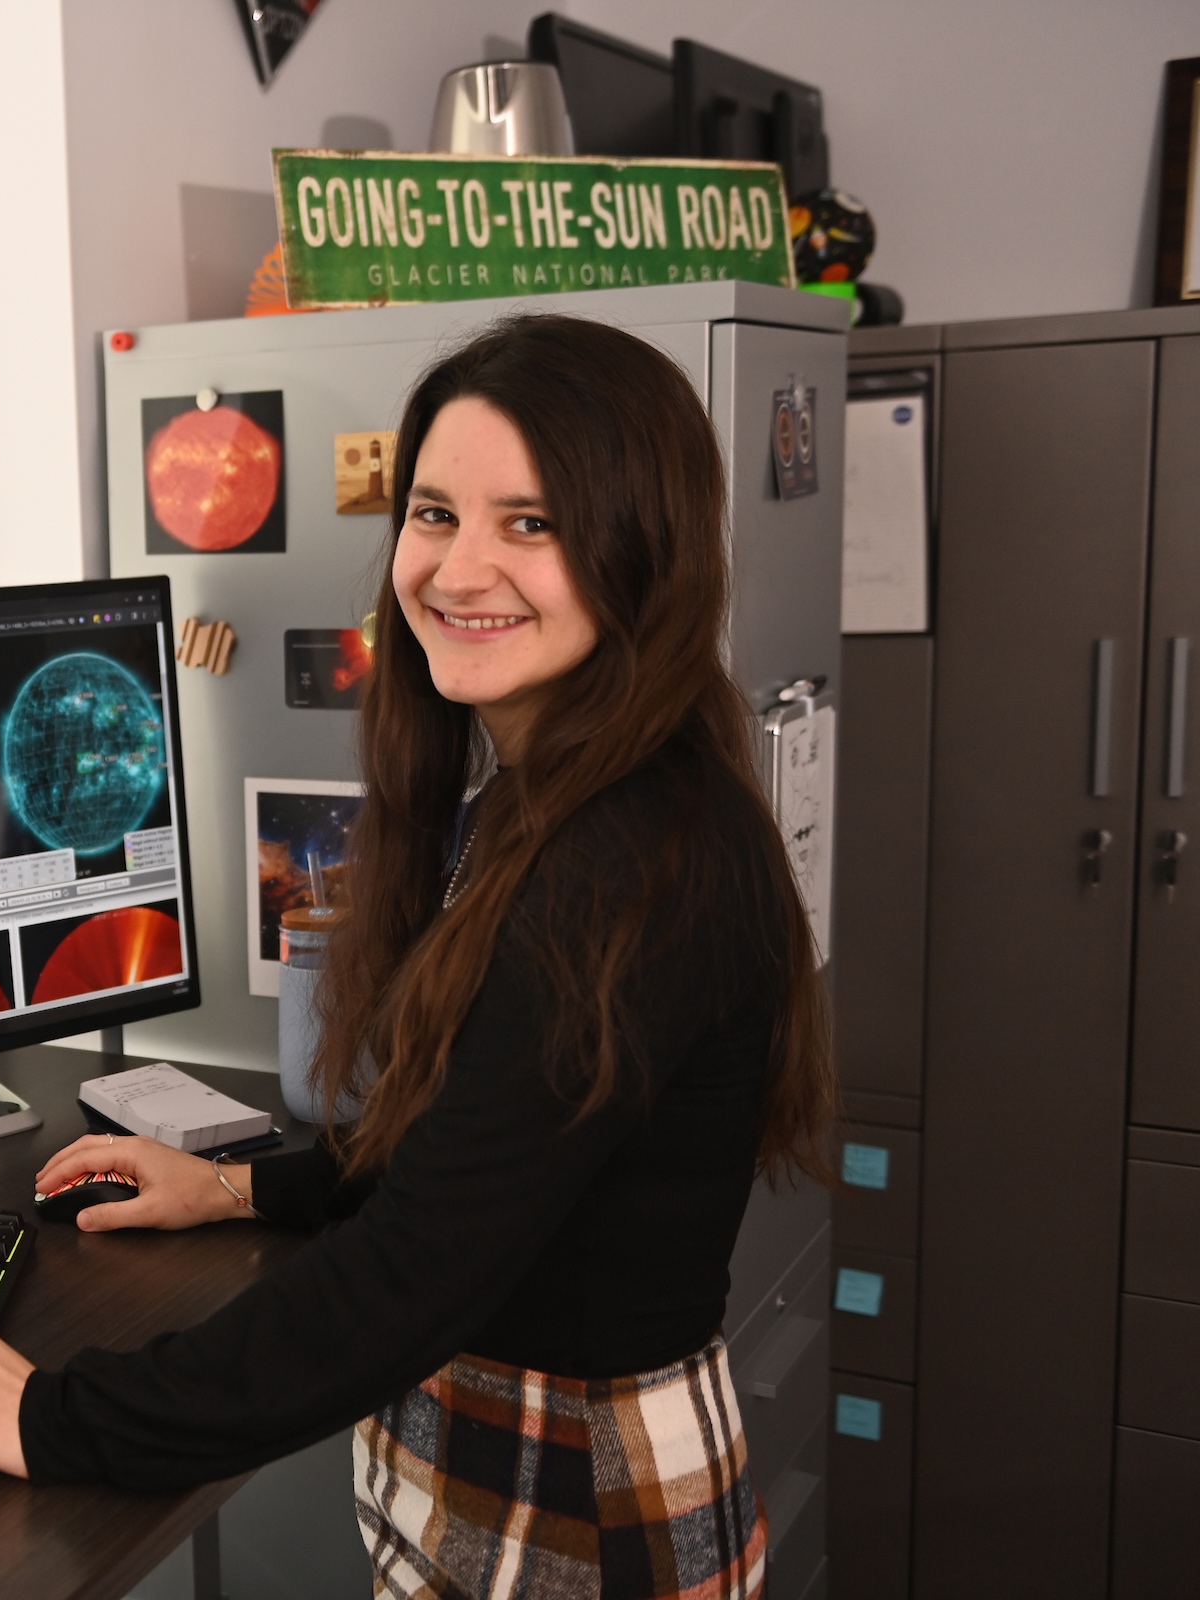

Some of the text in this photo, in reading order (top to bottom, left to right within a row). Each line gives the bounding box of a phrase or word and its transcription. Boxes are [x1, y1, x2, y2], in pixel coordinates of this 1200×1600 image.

[297, 175, 774, 250] GOING-TO-THE-SUN ROAD
[367, 262, 729, 287] GLACIER NATIONAL PARK
